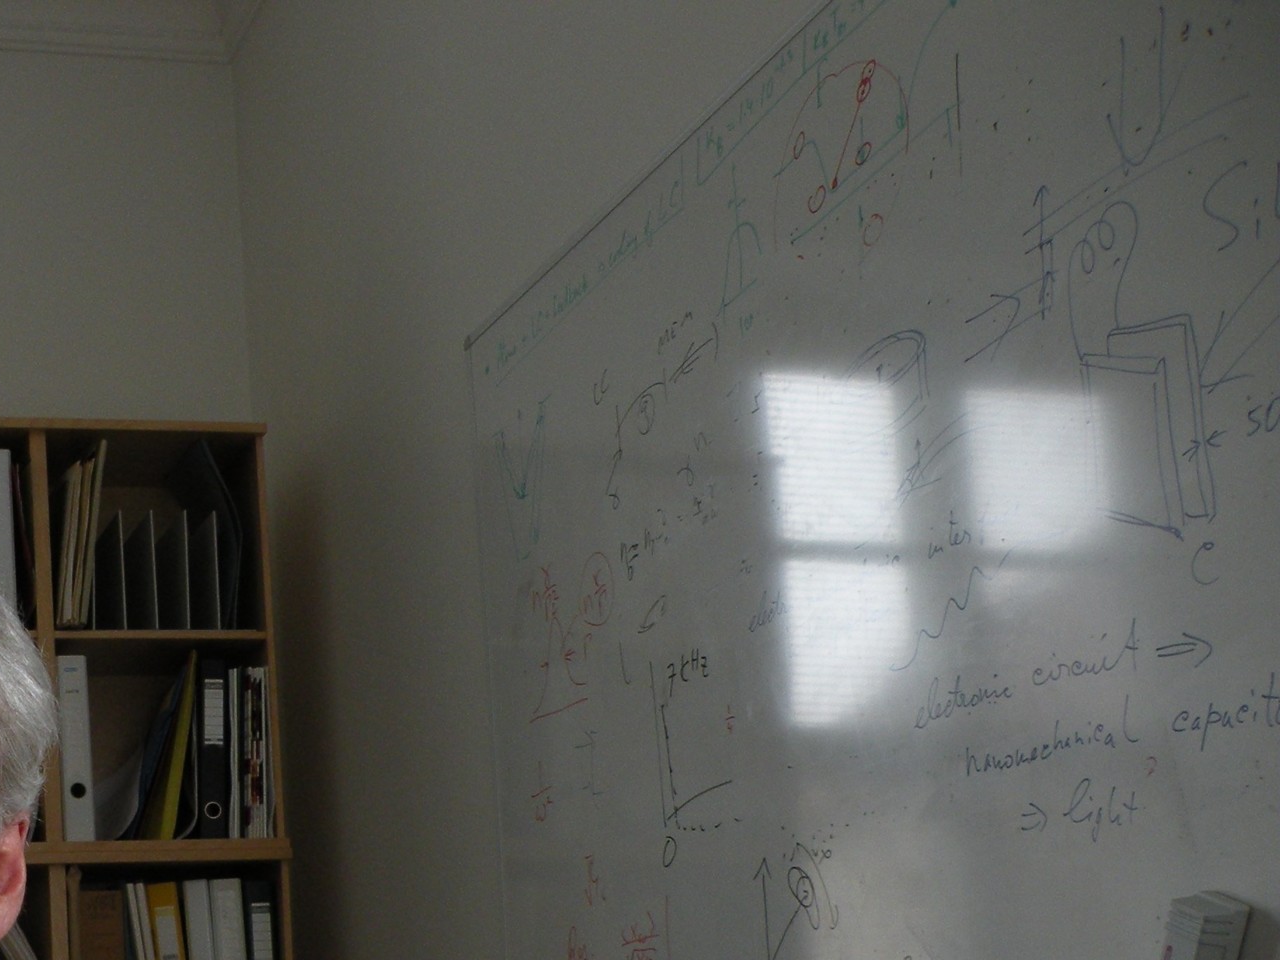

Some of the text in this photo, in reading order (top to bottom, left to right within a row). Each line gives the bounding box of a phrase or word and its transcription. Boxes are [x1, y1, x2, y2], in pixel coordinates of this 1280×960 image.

[914, 617, 1139, 730] electronic circuit
[965, 694, 1139, 777] nanomechanical
[1063, 778, 1138, 842] light
